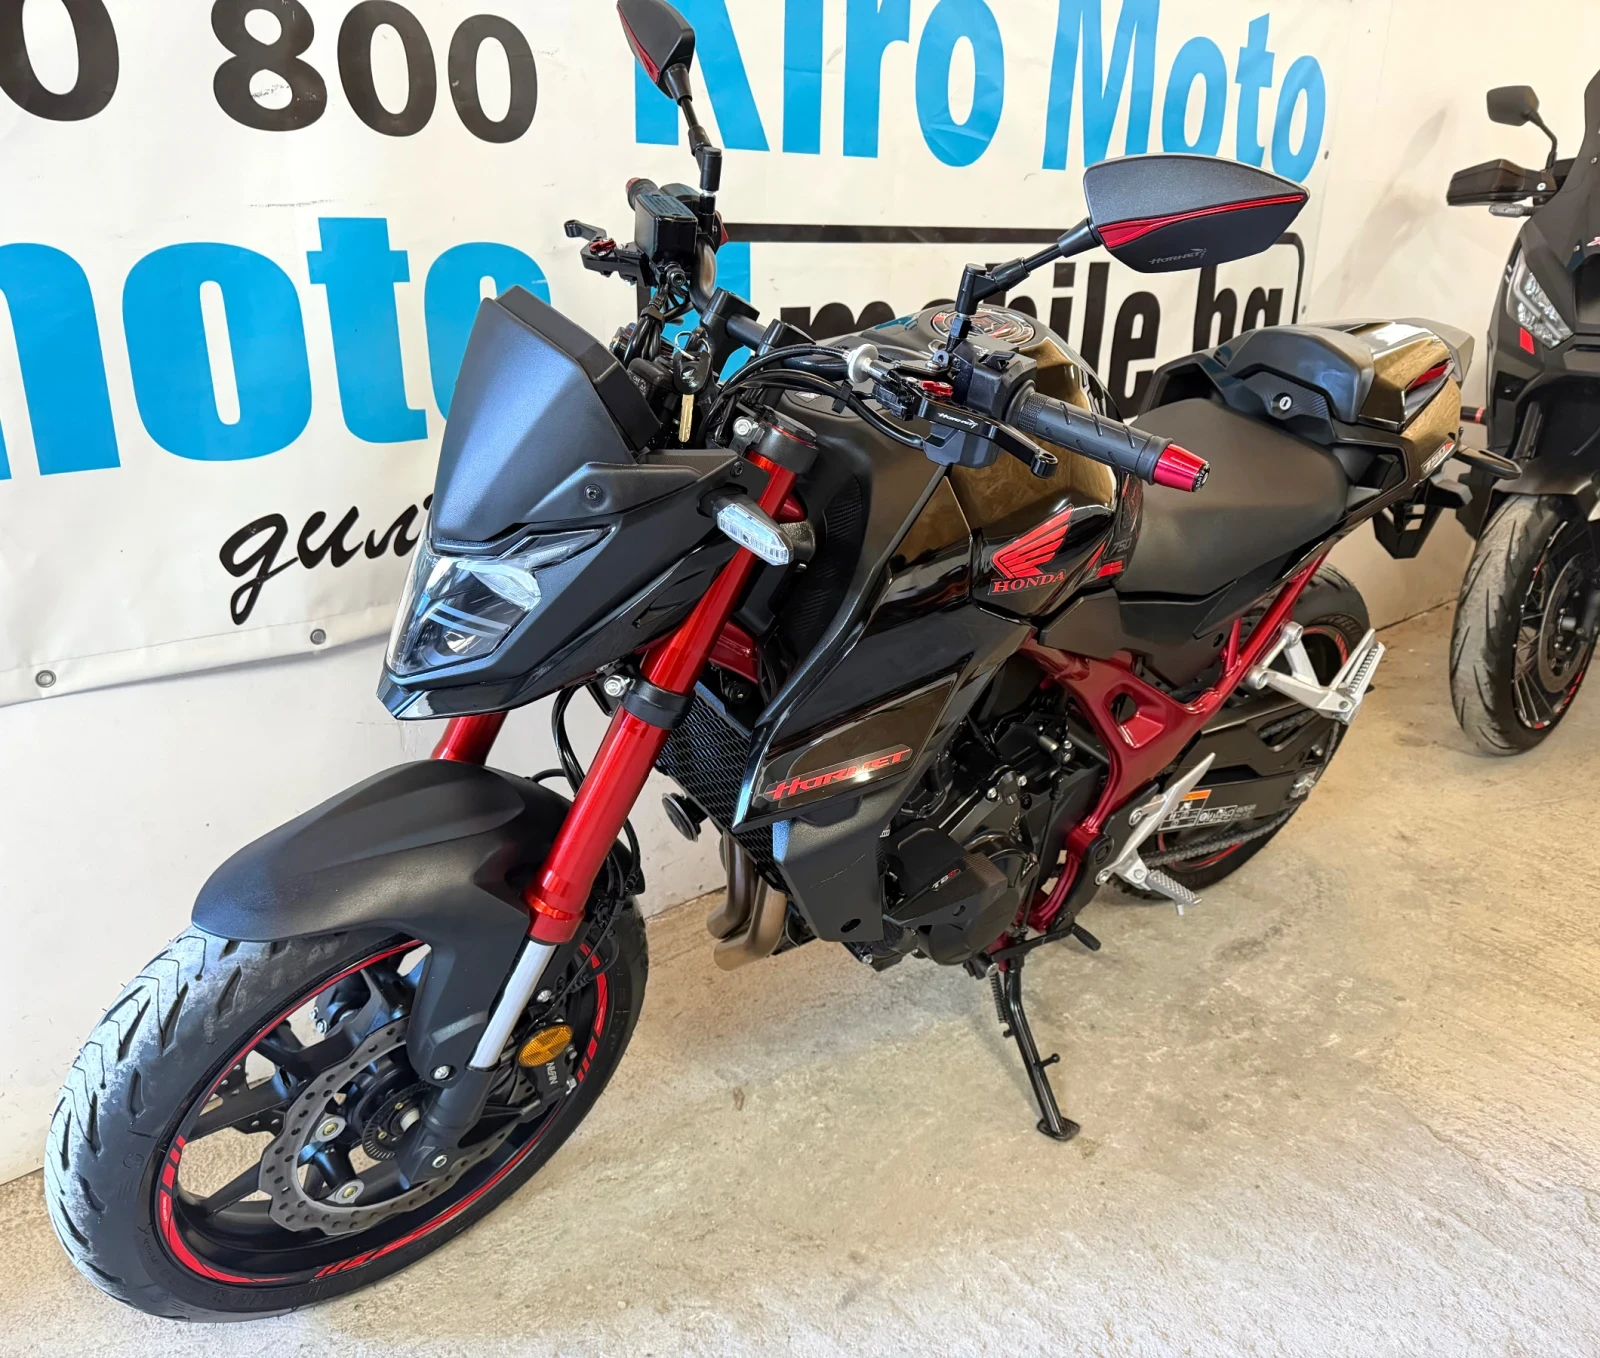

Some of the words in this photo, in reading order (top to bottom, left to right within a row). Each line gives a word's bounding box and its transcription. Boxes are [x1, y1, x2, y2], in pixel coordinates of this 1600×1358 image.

[211, 0, 538, 144] 800
[1042, 0, 1326, 184] Moto
[1148, 248, 1207, 265] HORNET
[1110, 537, 1133, 556] 750
[991, 571, 1066, 594] HONDA
